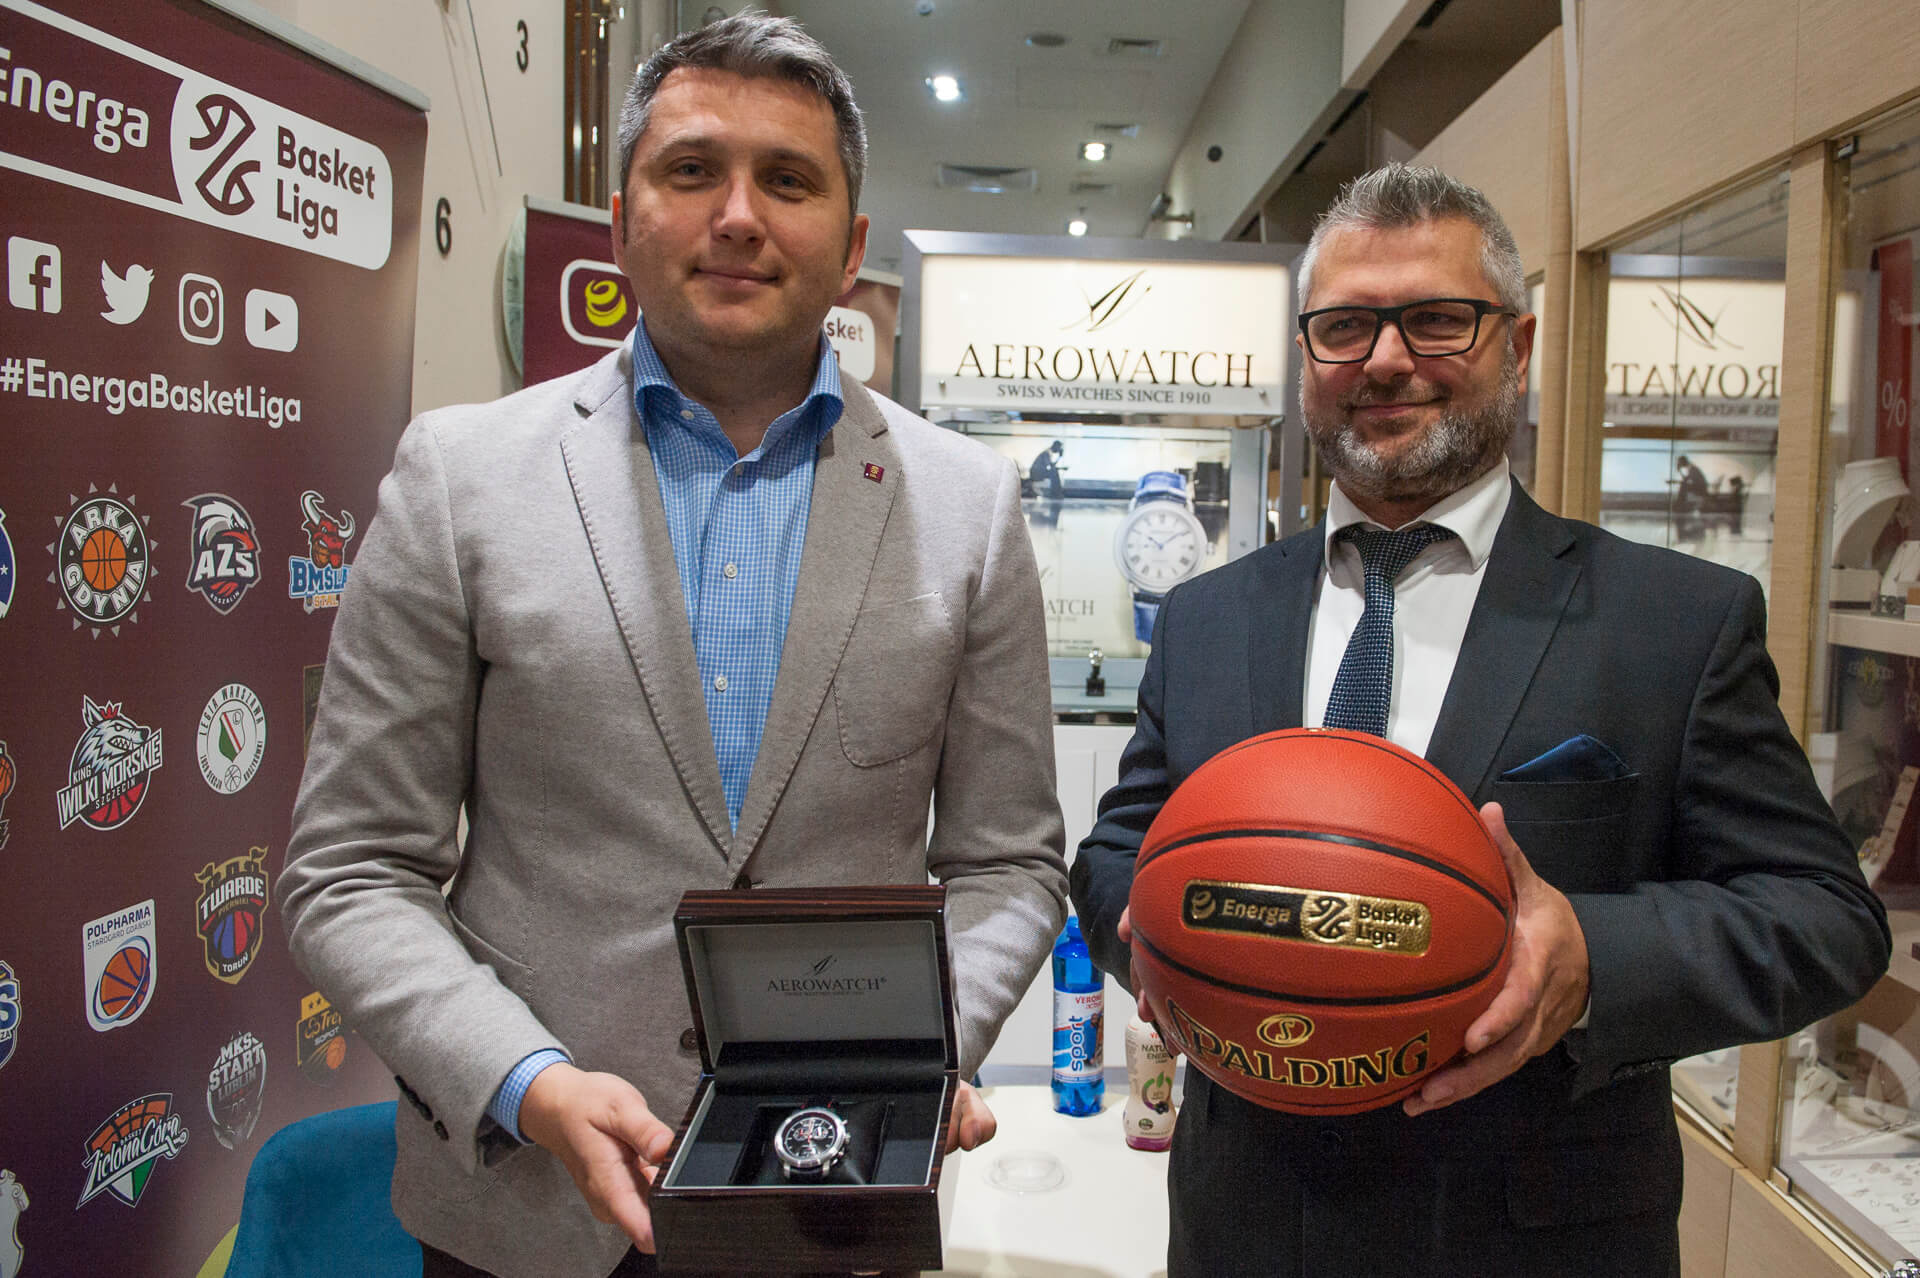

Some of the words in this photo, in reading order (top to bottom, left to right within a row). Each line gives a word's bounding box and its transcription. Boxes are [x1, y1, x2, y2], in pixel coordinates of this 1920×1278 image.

[276, 125, 376, 199] Basket
[276, 179, 339, 240] Liga
[434, 197, 453, 256] 6
[953, 343, 1255, 388] AEROWATCH
[0, 358, 302, 429] #EnergaBasketLiga
[997, 384, 1045, 399] SWISS
[1049, 386, 1124, 402] WATCHES
[1127, 389, 1174, 404] SINCE
[1179, 391, 1211, 405] 1910
[70, 504, 137, 551] ARKA
[194, 543, 255, 582] AZS
[64, 560, 145, 616] GDYNIA
[61, 775, 99, 823] WILKI
[102, 734, 161, 795] MORSKIE
[73, 764, 92, 785] KING
[95, 778, 136, 810] SZCZECIN
[200, 876, 265, 920] TWARDE
[1221, 899, 1292, 927] Energa
[1358, 903, 1422, 926] Basket
[87, 906, 151, 940] POLPHARMA
[1356, 923, 1398, 945] Liga
[221, 1032, 252, 1065] MKS
[1068, 1015, 1087, 1072] sport
[209, 1042, 264, 1092] START
